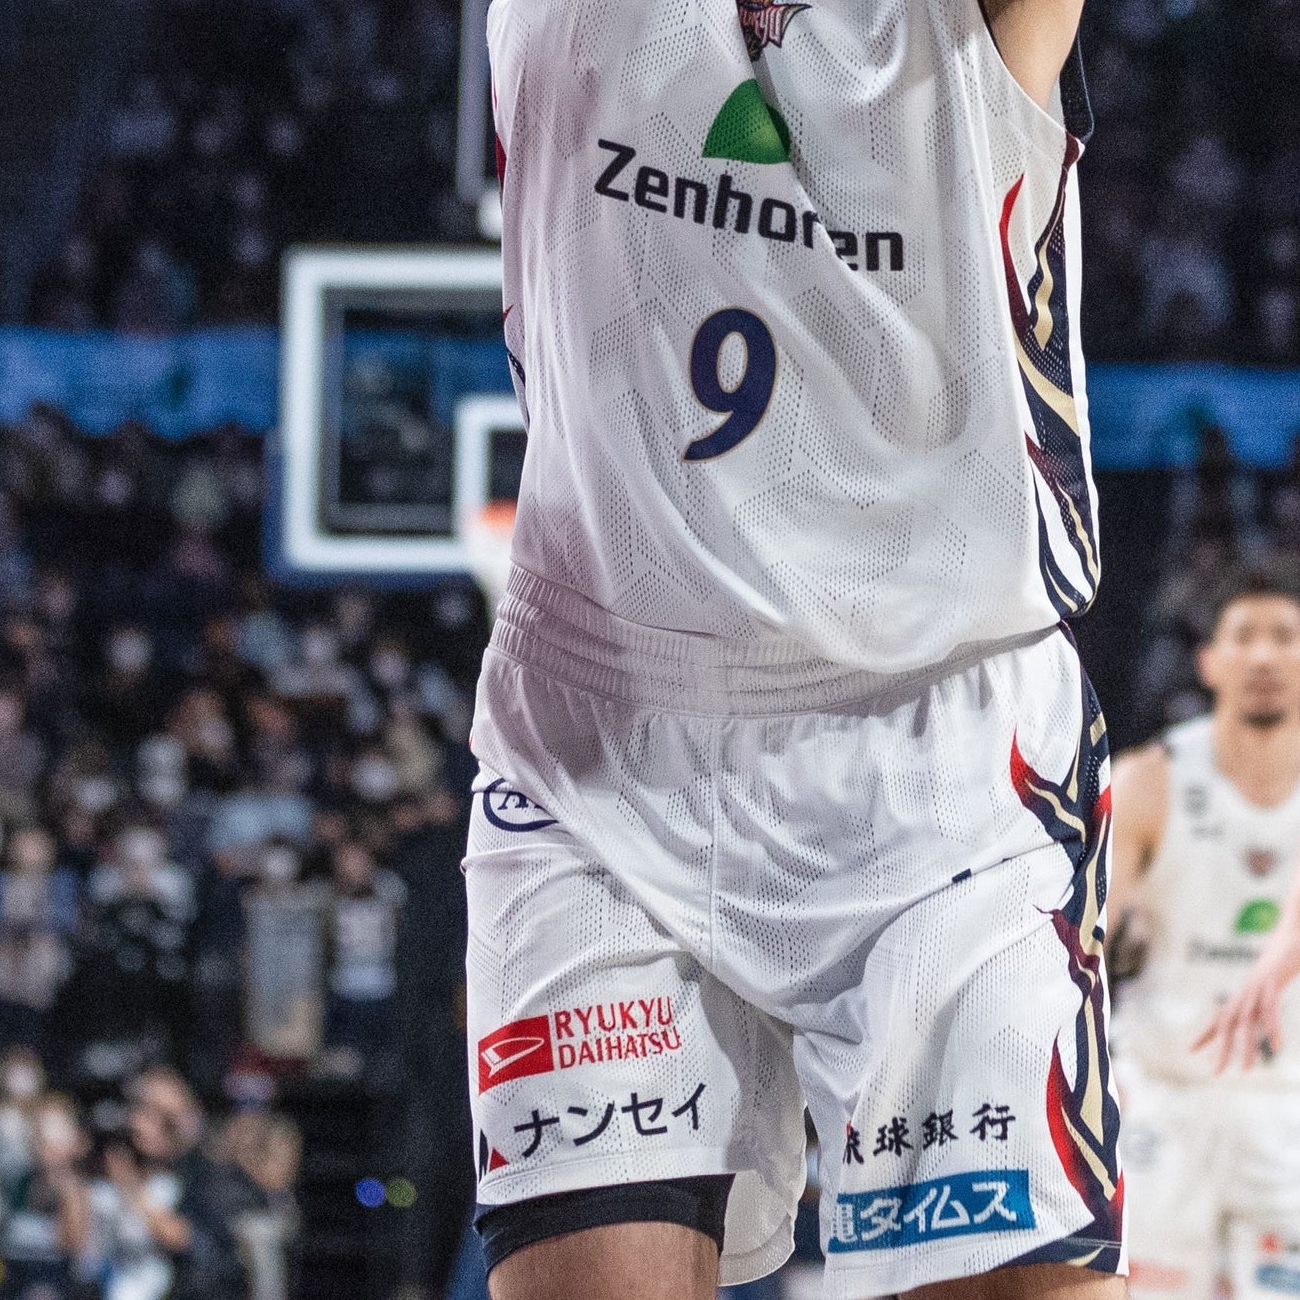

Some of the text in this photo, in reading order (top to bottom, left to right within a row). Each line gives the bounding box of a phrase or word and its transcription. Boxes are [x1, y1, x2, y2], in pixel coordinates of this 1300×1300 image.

[594, 138, 905, 273] Zenhoren
[680, 305, 778, 463] 9
[554, 996, 674, 1040] RYUKYU
[558, 1026, 681, 1070] DAIHATSU
[514, 1082, 707, 1159] ナンセイ
